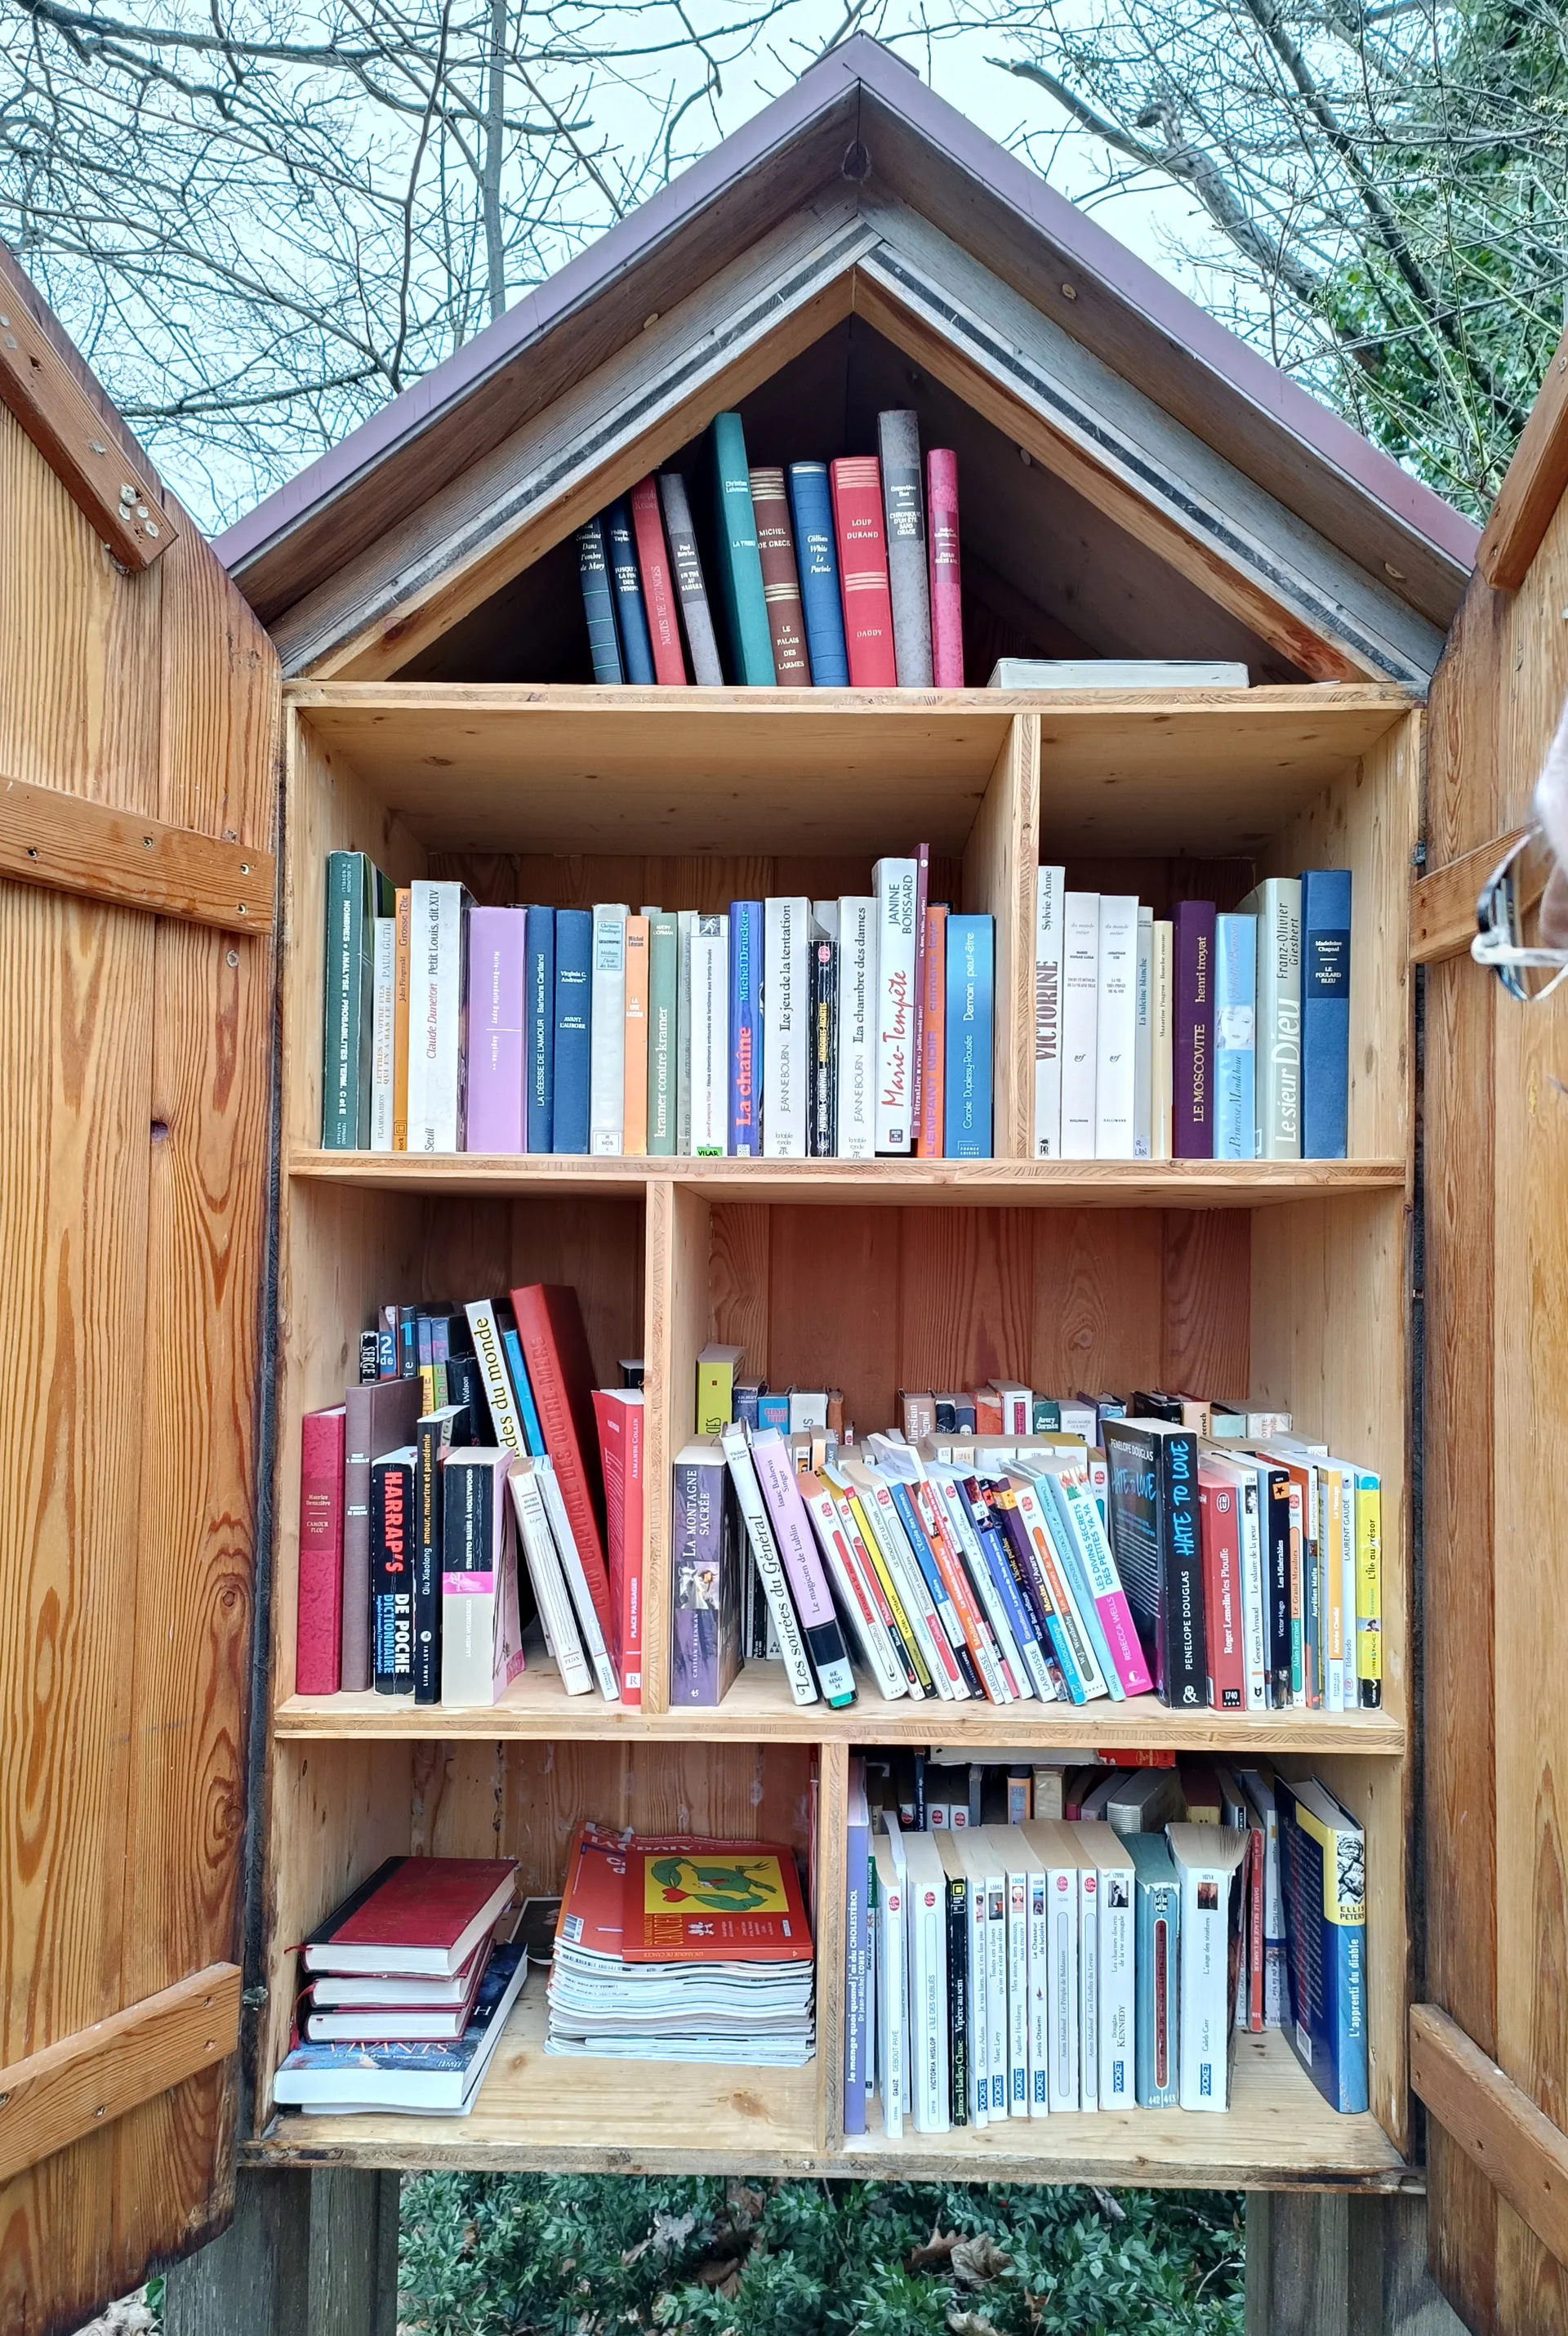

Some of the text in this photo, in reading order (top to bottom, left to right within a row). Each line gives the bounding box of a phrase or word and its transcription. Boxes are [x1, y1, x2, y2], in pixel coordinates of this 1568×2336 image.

[759, 528, 786, 537] MICHEL
[808, 534, 828, 542] Gillian
[810, 545, 827, 553] White
[589, 563, 604, 571] Mary
[651, 566, 671, 645] NUITS DE PRINCES
[857, 629, 882, 637] DADDY
[777, 637, 799, 645] PALAIS
[778, 661, 804, 670] LARMES
[399, 894, 408, 947] Grosse Tête
[889, 884, 900, 925] JANINE
[902, 875, 913, 934] BOISSARD
[1042, 870, 1052, 931] Sylvie Anne
[382, 923, 391, 978] PAUL GUTH
[428, 889, 440, 975] Petit Louis, XIV
[739, 911, 749, 1001] Michel Drucker
[779, 904, 794, 1013] jeu de tentation
[1276, 902, 1290, 979] Franz-Olivier
[1288, 917, 1298, 965] Giesbert
[340, 899, 351, 1061] NOMBRES ANALYSE PROBABILITES
[537, 953, 545, 1014] Barbara Cartland
[853, 907, 866, 1023] chambre des dames
[963, 932, 978, 1021] Demain peut-être
[1195, 936, 1209, 1002] henri troyat
[426, 983, 438, 1059] Claude Duneton
[881, 970, 913, 1107] Marie-Tempête
[1036, 960, 1058, 1061] VICTORINE
[653, 1006, 668, 1138] kramer contre kramer
[735, 1026, 751, 1127] La chaîne
[780, 1045, 791, 1112] JEANNE BOURIN
[914, 1076, 922, 1116] TétrasLire
[962, 1034, 975, 1129] Carole Duplessy-Rousée
[1193, 1023, 1205, 1122] LE MOSCOVITE
[1270, 997, 1301, 1143] Le sieur Dieu
[380, 1335, 393, 1354] 2
[380, 1355, 394, 1366] de
[474, 1317, 508, 1410] du monde
[461, 1375, 470, 1404] Watson
[907, 1404, 918, 1446] Christian
[920, 1411, 933, 1438] Signol
[1111, 1438, 1153, 1461] PENELOPE DOUGLAS
[422, 1433, 432, 1545] amour, meurtre et pandémie
[683, 1469, 697, 1557] LA MONTAGNE
[698, 1491, 710, 1536] SACRÉE
[1170, 1439, 1195, 1556] HATE TO LOVE
[384, 1471, 403, 1573] HARRAP'S
[1343, 1499, 1352, 1562] LAURENT GAUDÉ
[421, 1548, 432, 1595] Qiu Xiaolong
[791, 1523, 818, 1603] magicien Lublin
[1029, 1555, 1040, 1585] L'Avare
[748, 1514, 810, 1696] Les soirées du Général
[1106, 1596, 1133, 1661] REBECCA WELLS
[1220, 1548, 1233, 1655] Roger Plouffe
[1277, 1600, 1285, 1617] Hugo
[384, 1594, 394, 1674] DICTIONNAIRE
[394, 1594, 410, 1674] DE POCHE
[1184, 1620, 1193, 1670] PENELOPE
[1252, 1607, 1262, 1665] Georges Arnaud
[980, 1654, 1000, 1697] LAROUSSE
[1030, 1648, 1051, 1692] LAROUSSE
[1225, 1692, 1237, 1701] 1740
[1340, 1906, 1365, 1914] ELLIS
[848, 1889, 858, 2084] Je mange quoi quand j'ai du CHOLESTÉROL
[1348, 1938, 1361, 2038] L'apprenti du diable
[955, 2006, 965, 2033] Vipère
[1116, 2004, 1126, 2048] KENNEDY
[955, 2040, 965, 2118] James Hadley Chase
[993, 2075, 1003, 2106] POCKET
[1014, 2068, 1025, 2100] POCKET
[1035, 2071, 1045, 2102] POCKET
[1113, 2061, 1124, 2093] POCKET
[1200, 2063, 1211, 2096] POCKET
